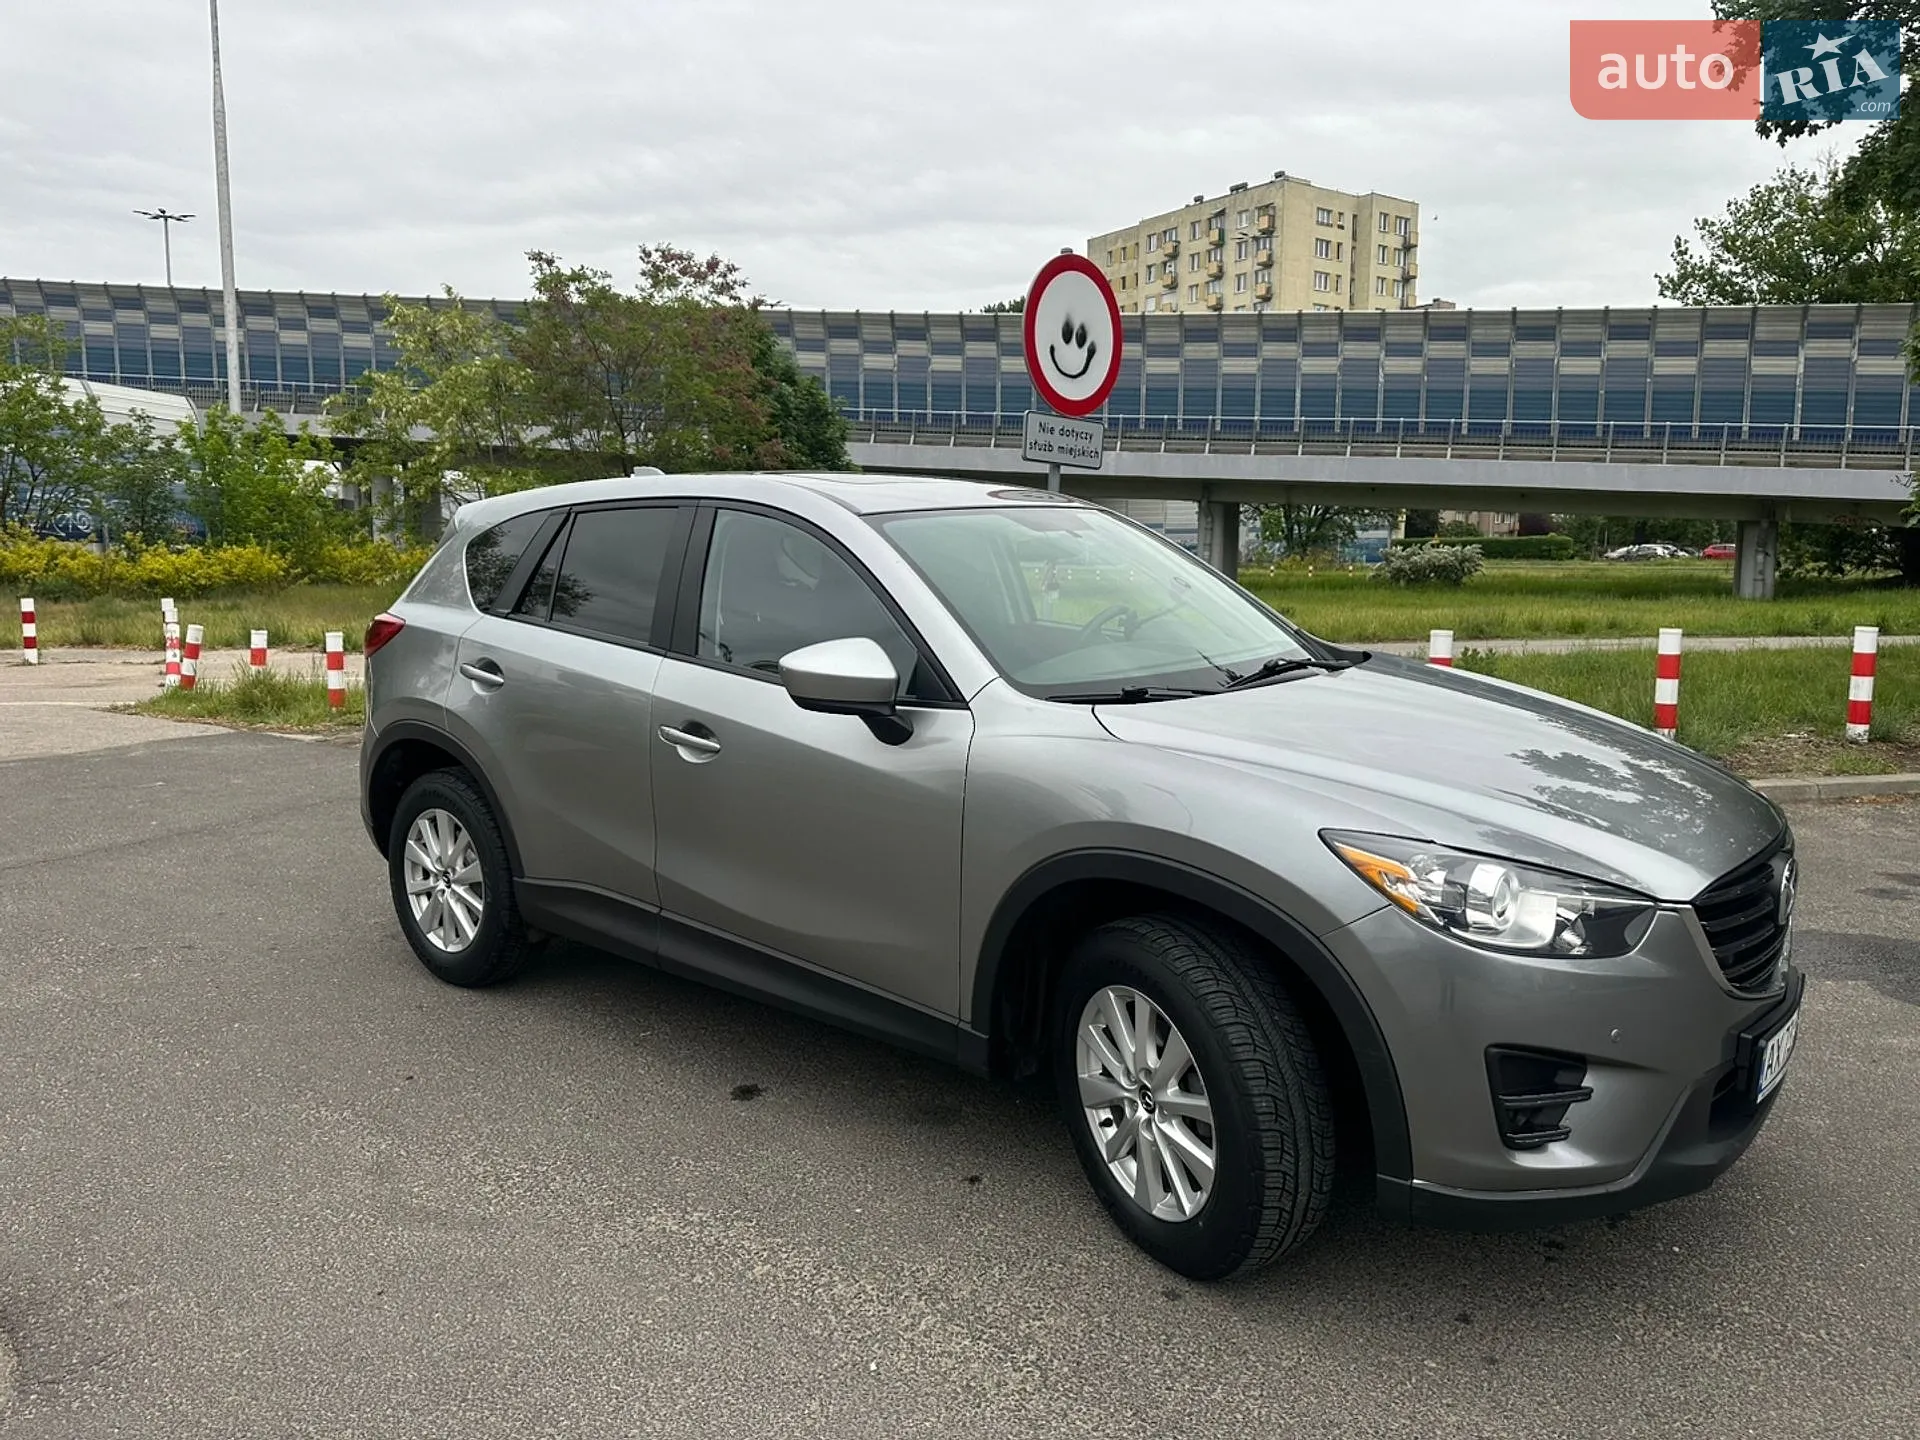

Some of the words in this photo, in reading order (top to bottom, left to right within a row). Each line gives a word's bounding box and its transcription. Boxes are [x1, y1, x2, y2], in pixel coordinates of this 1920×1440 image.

[1038, 421, 1055, 435] Nie
[1058, 425, 1094, 443] dotyczy
[1057, 443, 1100, 459] miejskich
